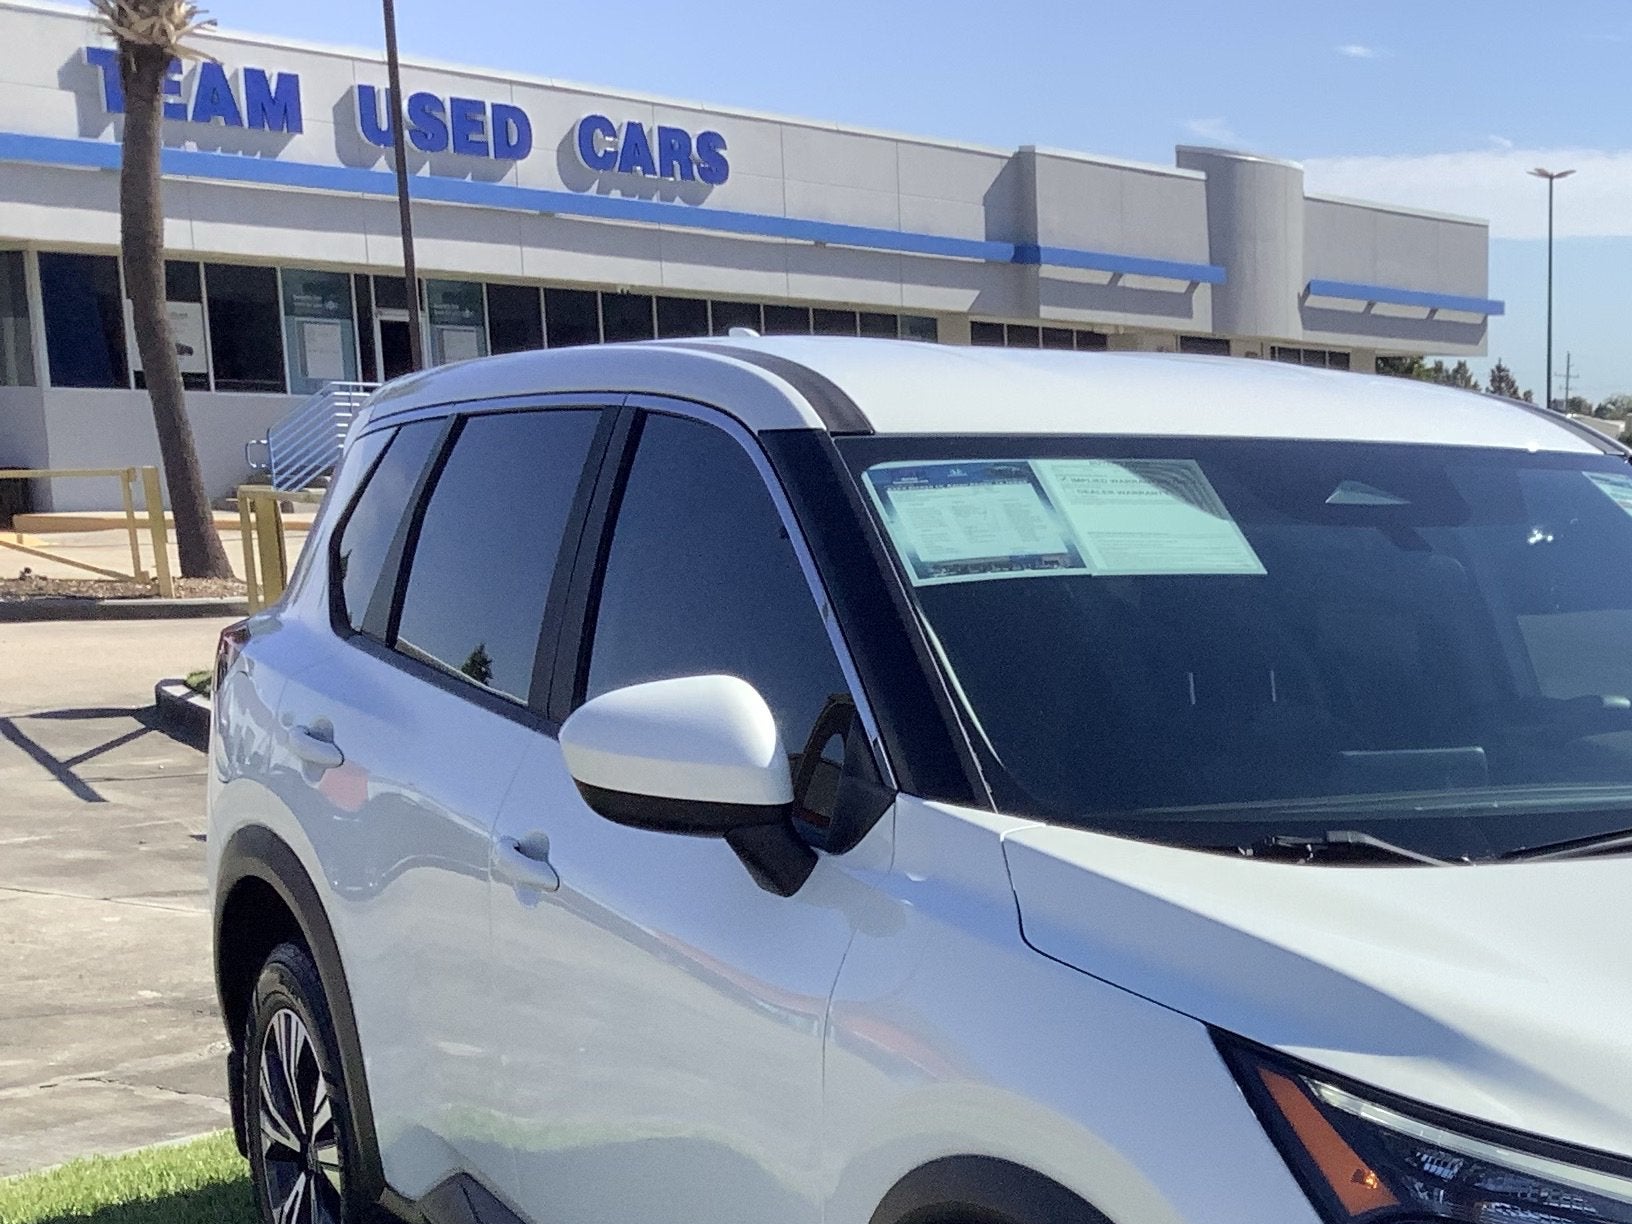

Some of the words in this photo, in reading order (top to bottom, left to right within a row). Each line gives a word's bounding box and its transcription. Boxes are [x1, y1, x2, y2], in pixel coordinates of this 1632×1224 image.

[86, 46, 303, 135] TEAM
[356, 84, 533, 161] USED
[577, 114, 730, 186] CARS
